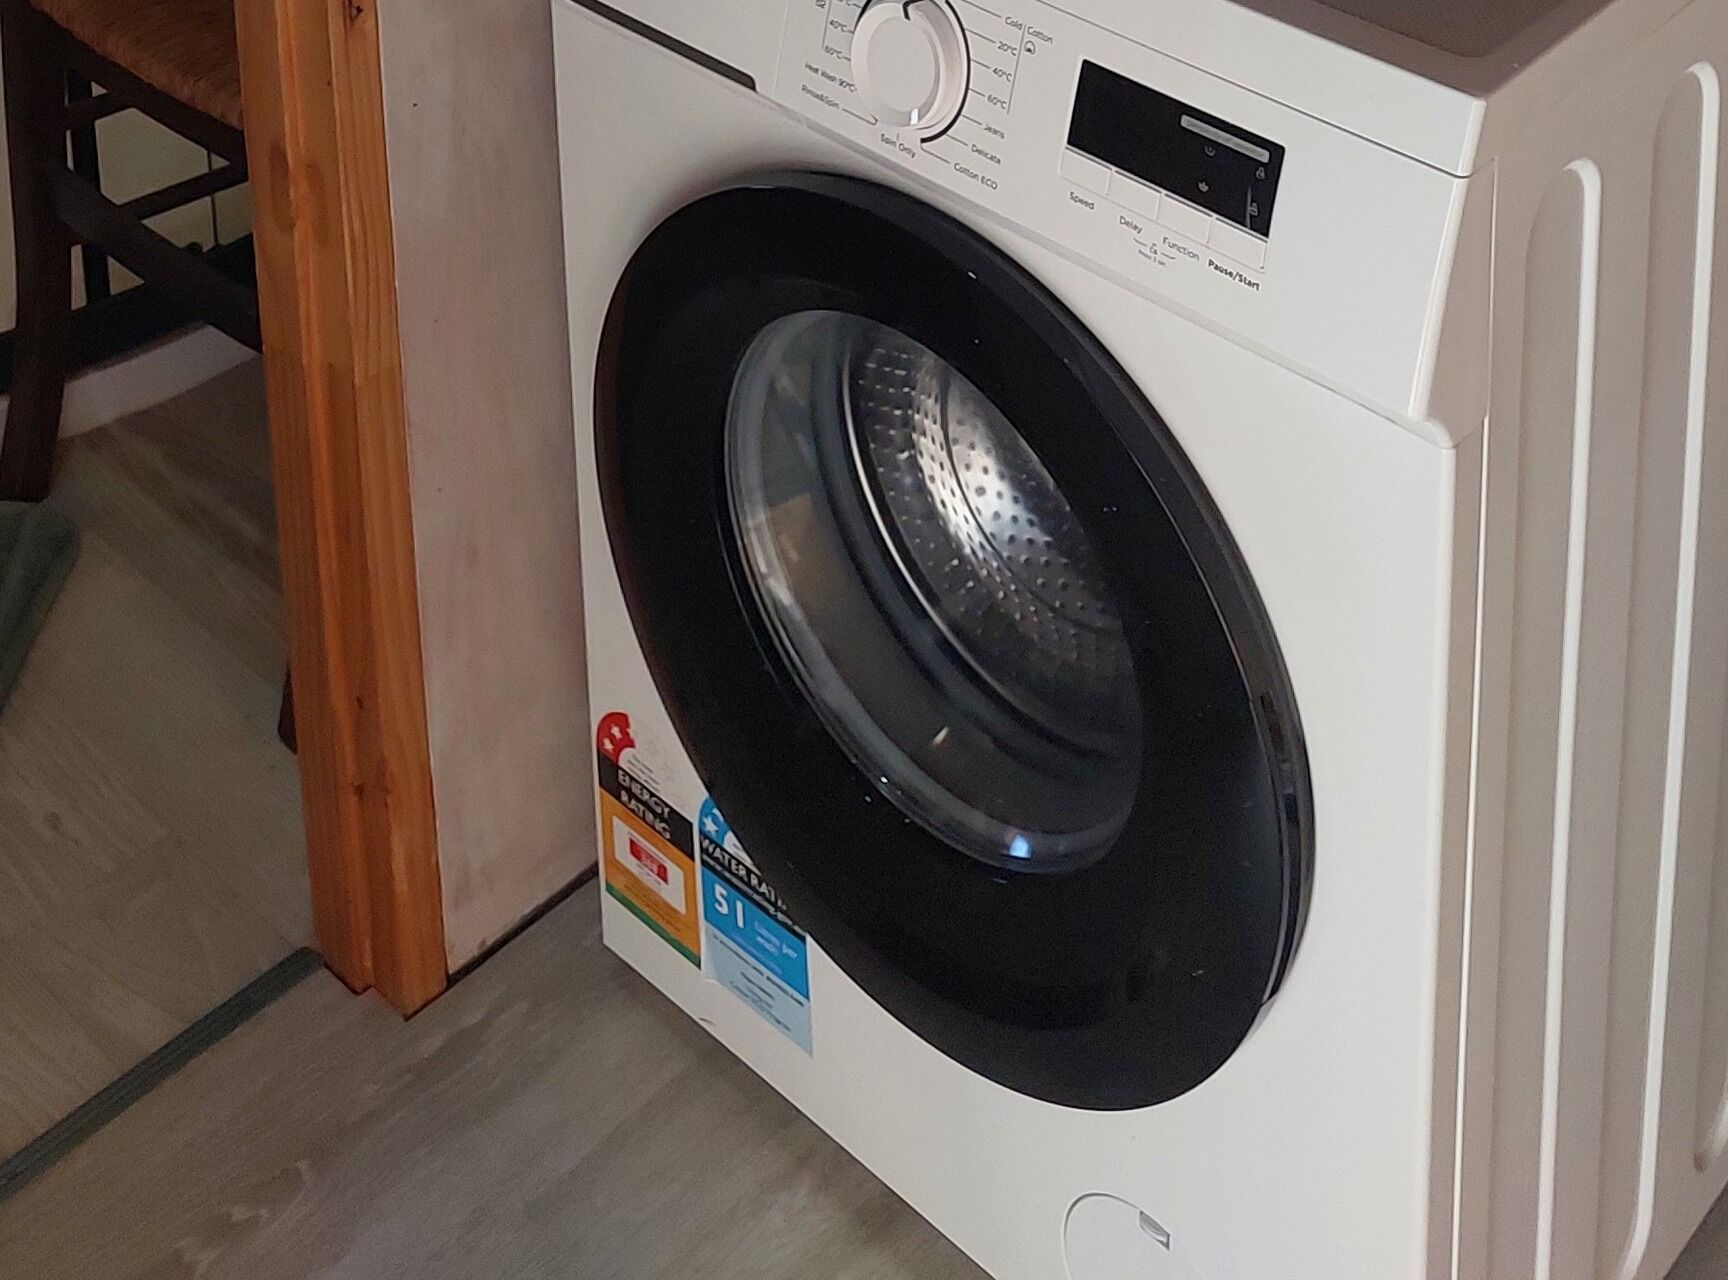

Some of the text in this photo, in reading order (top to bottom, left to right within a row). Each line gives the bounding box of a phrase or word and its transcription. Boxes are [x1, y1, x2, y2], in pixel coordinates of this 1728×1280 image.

[1004, 16, 1053, 45] Cold Cotton
[997, 40, 1017, 57] 20°C
[992, 66, 1013, 83] 40°C
[987, 93, 1007, 111] 60°C
[898, 142, 916, 159] Only
[953, 161, 998, 191] Cotton ECO
[1069, 191, 1096, 211] Speed
[1119, 214, 1144, 235] Delay
[1161, 235, 1201, 261] Function
[1207, 257, 1261, 291] Pause/Start
[618, 767, 671, 820] ENERGY
[620, 789, 672, 840] RATING
[700, 834, 748, 882] WATER
